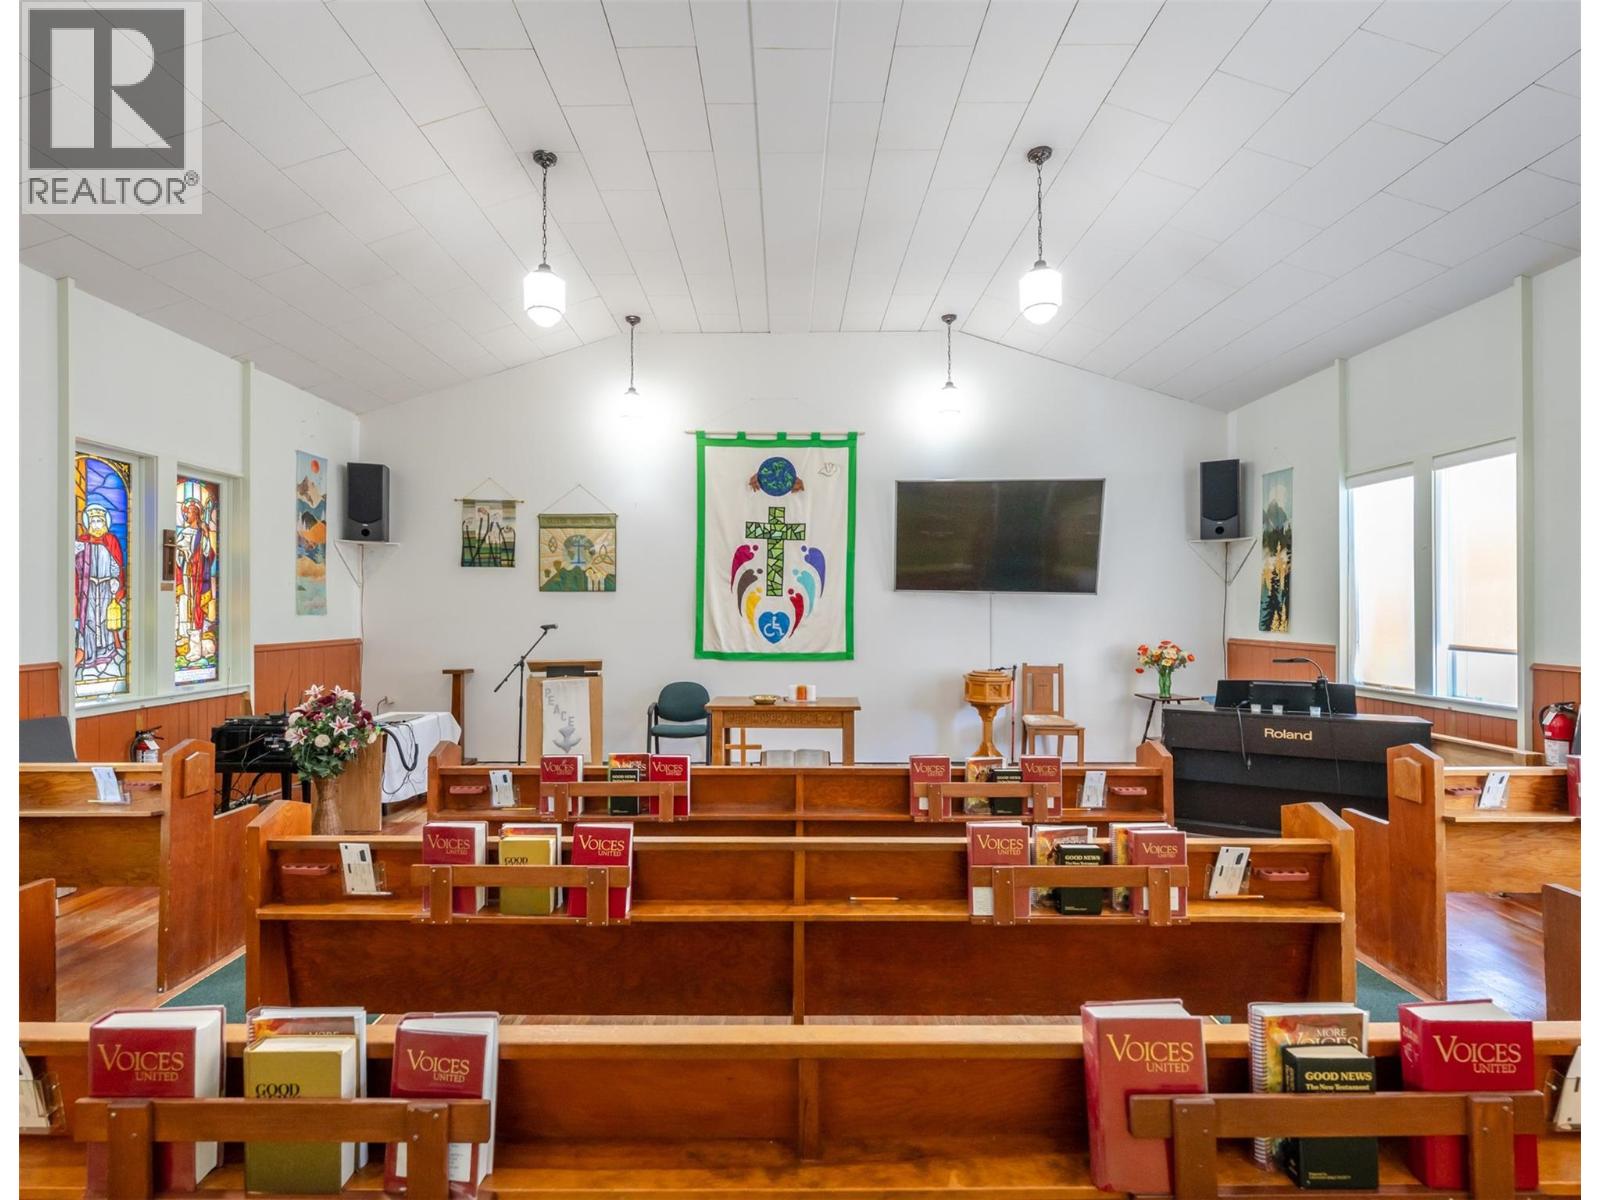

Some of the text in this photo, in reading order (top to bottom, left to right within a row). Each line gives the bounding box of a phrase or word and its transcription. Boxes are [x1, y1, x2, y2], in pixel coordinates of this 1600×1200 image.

[544, 687, 575, 728] PEACE
[1264, 727, 1313, 741] Roland
[427, 834, 471, 849] VOICES
[579, 834, 625, 851] VOICES
[976, 834, 1024, 850] VOICES
[1142, 842, 1178, 855] VOICES
[504, 856, 529, 865] GOOD
[1316, 1028, 1348, 1037] MORE
[1107, 1034, 1194, 1062] VOICES
[1433, 1035, 1522, 1064] VOICES
[97, 1044, 184, 1072] VOICES
[407, 1049, 470, 1075] VOICES
[1146, 1062, 1190, 1073] UNITED
[1473, 1063, 1517, 1074] UNITED
[136, 1071, 179, 1082] UNITED
[433, 1073, 465, 1083] UNITED
[1305, 1072, 1373, 1081] GOOD NEWS
[255, 1083, 300, 1097] GOOD
[1305, 1083, 1319, 1091] The
